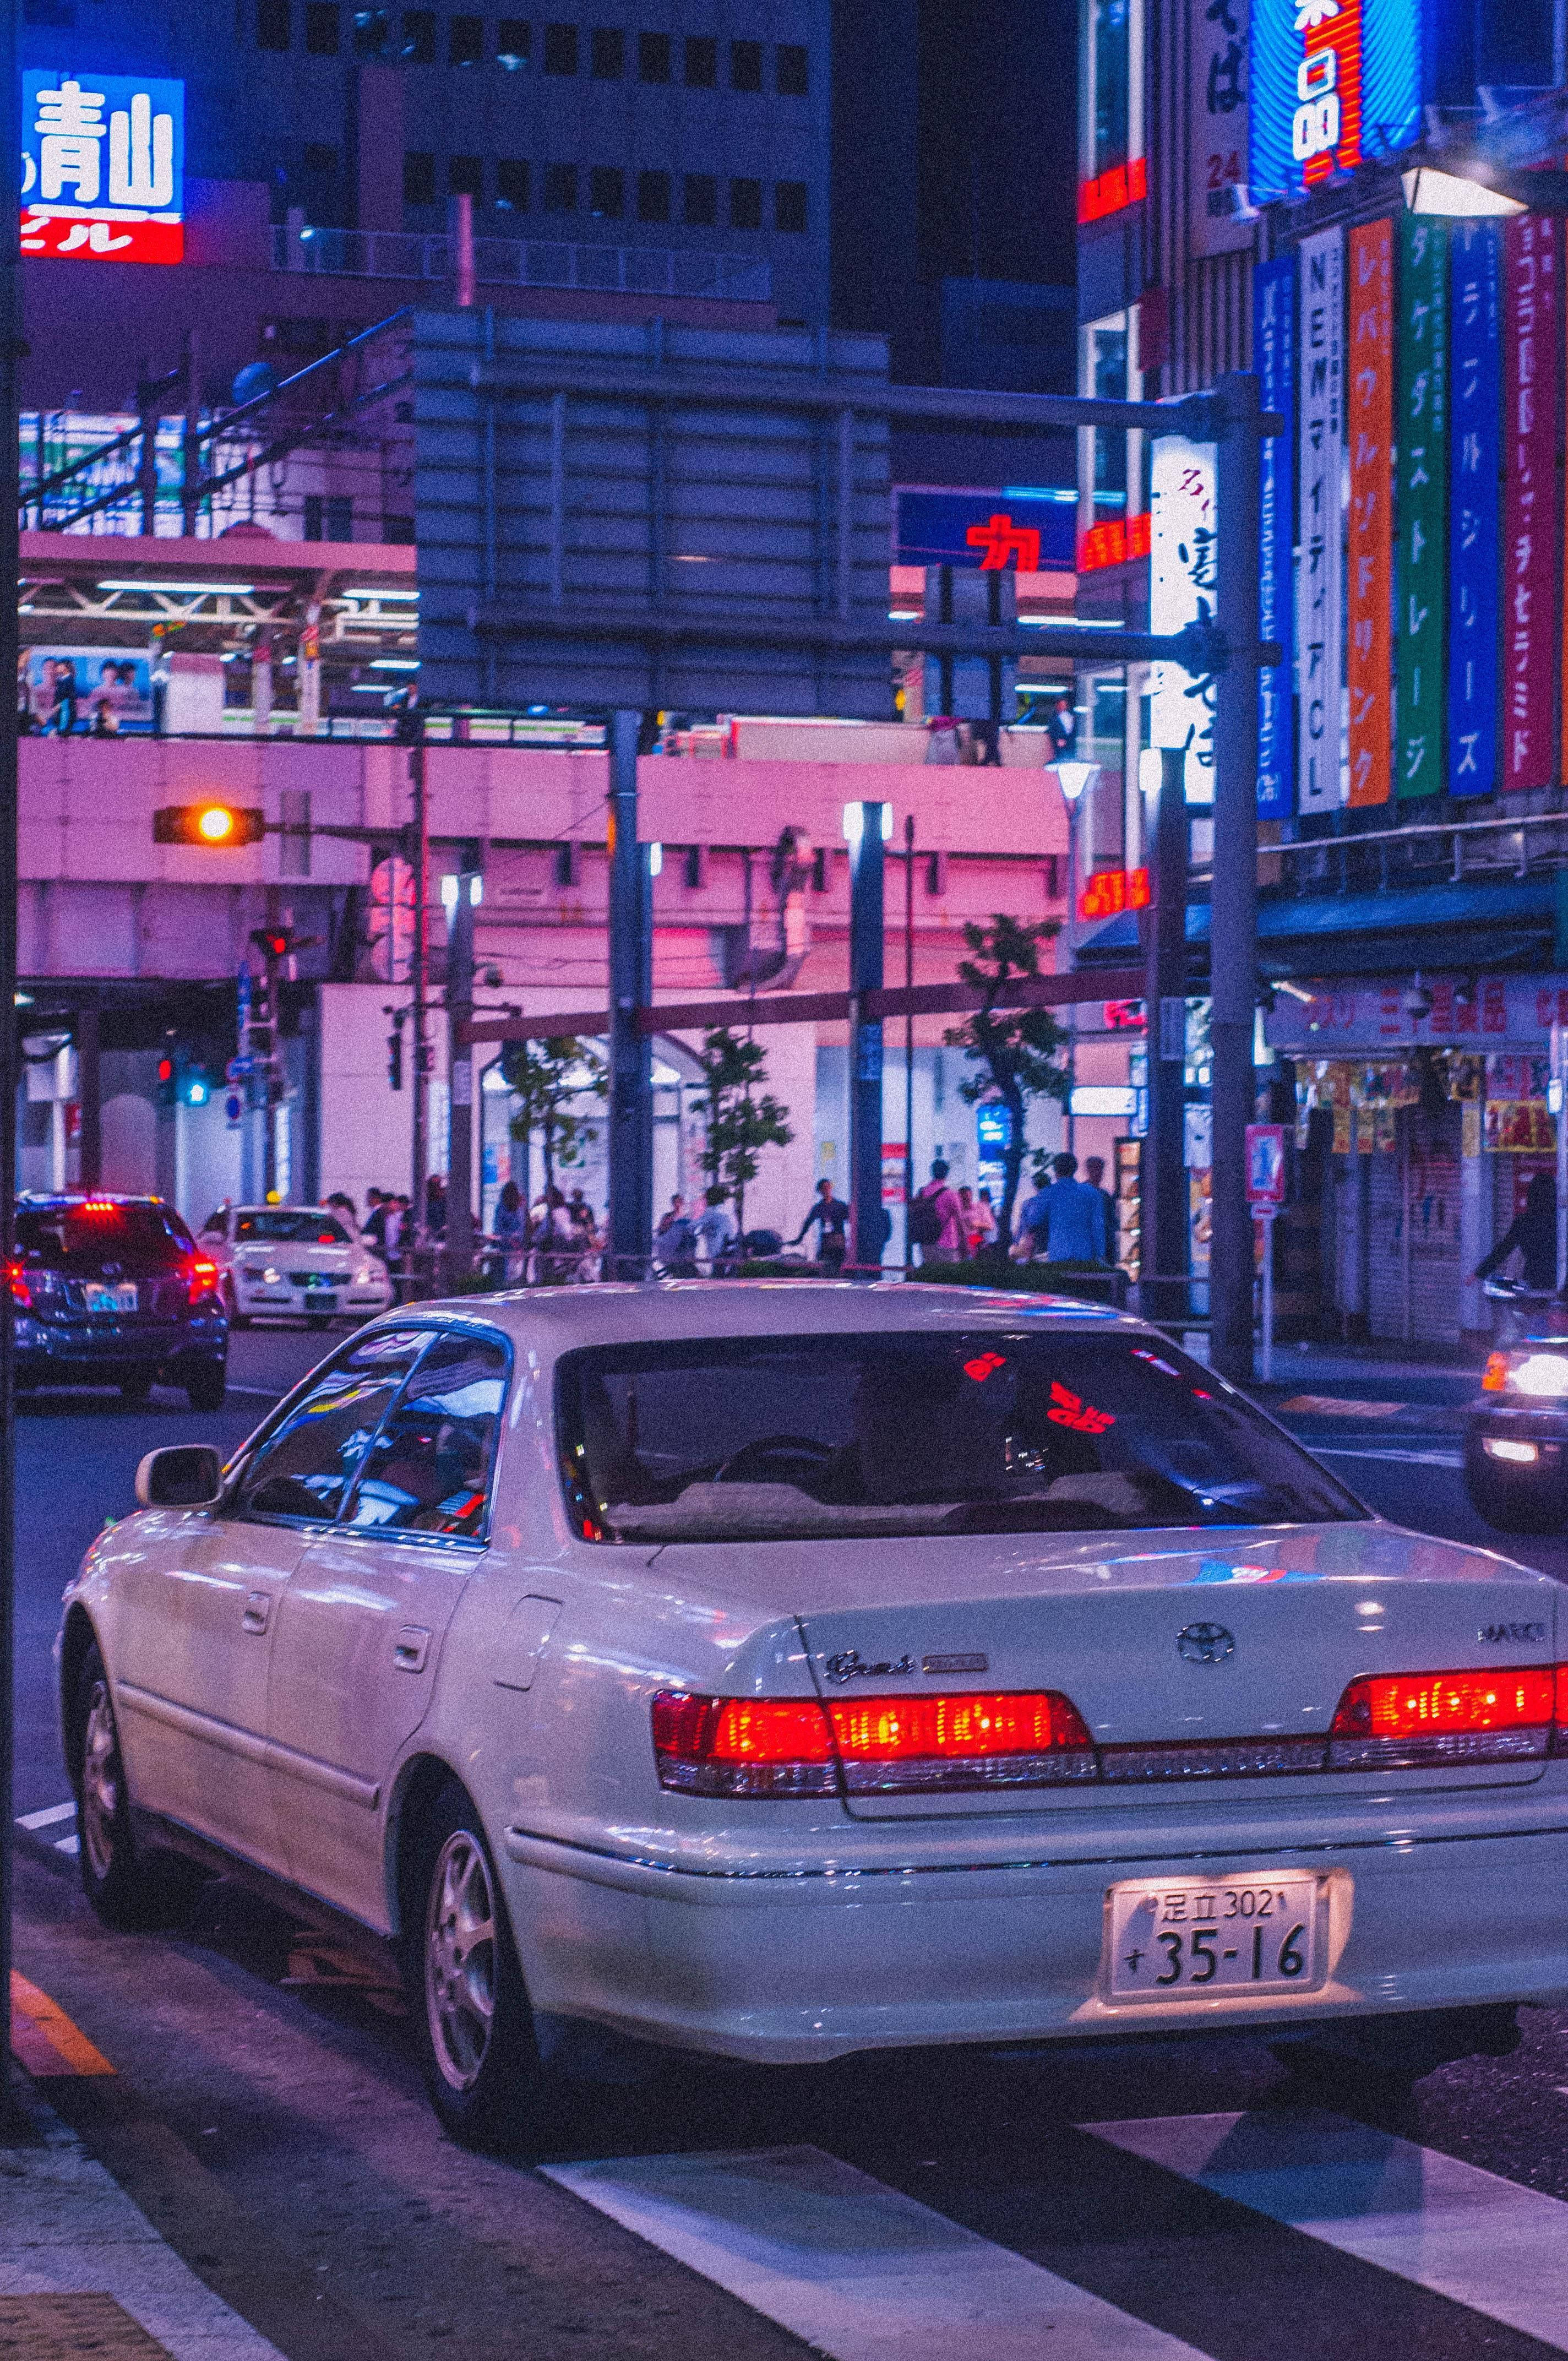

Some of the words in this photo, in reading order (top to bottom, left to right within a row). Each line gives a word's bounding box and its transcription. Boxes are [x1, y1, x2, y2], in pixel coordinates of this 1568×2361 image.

[1162, 1893, 1217, 1922] 足立
[1224, 1889, 1273, 1919] 302
[1156, 1922, 1305, 1985] 35-16
